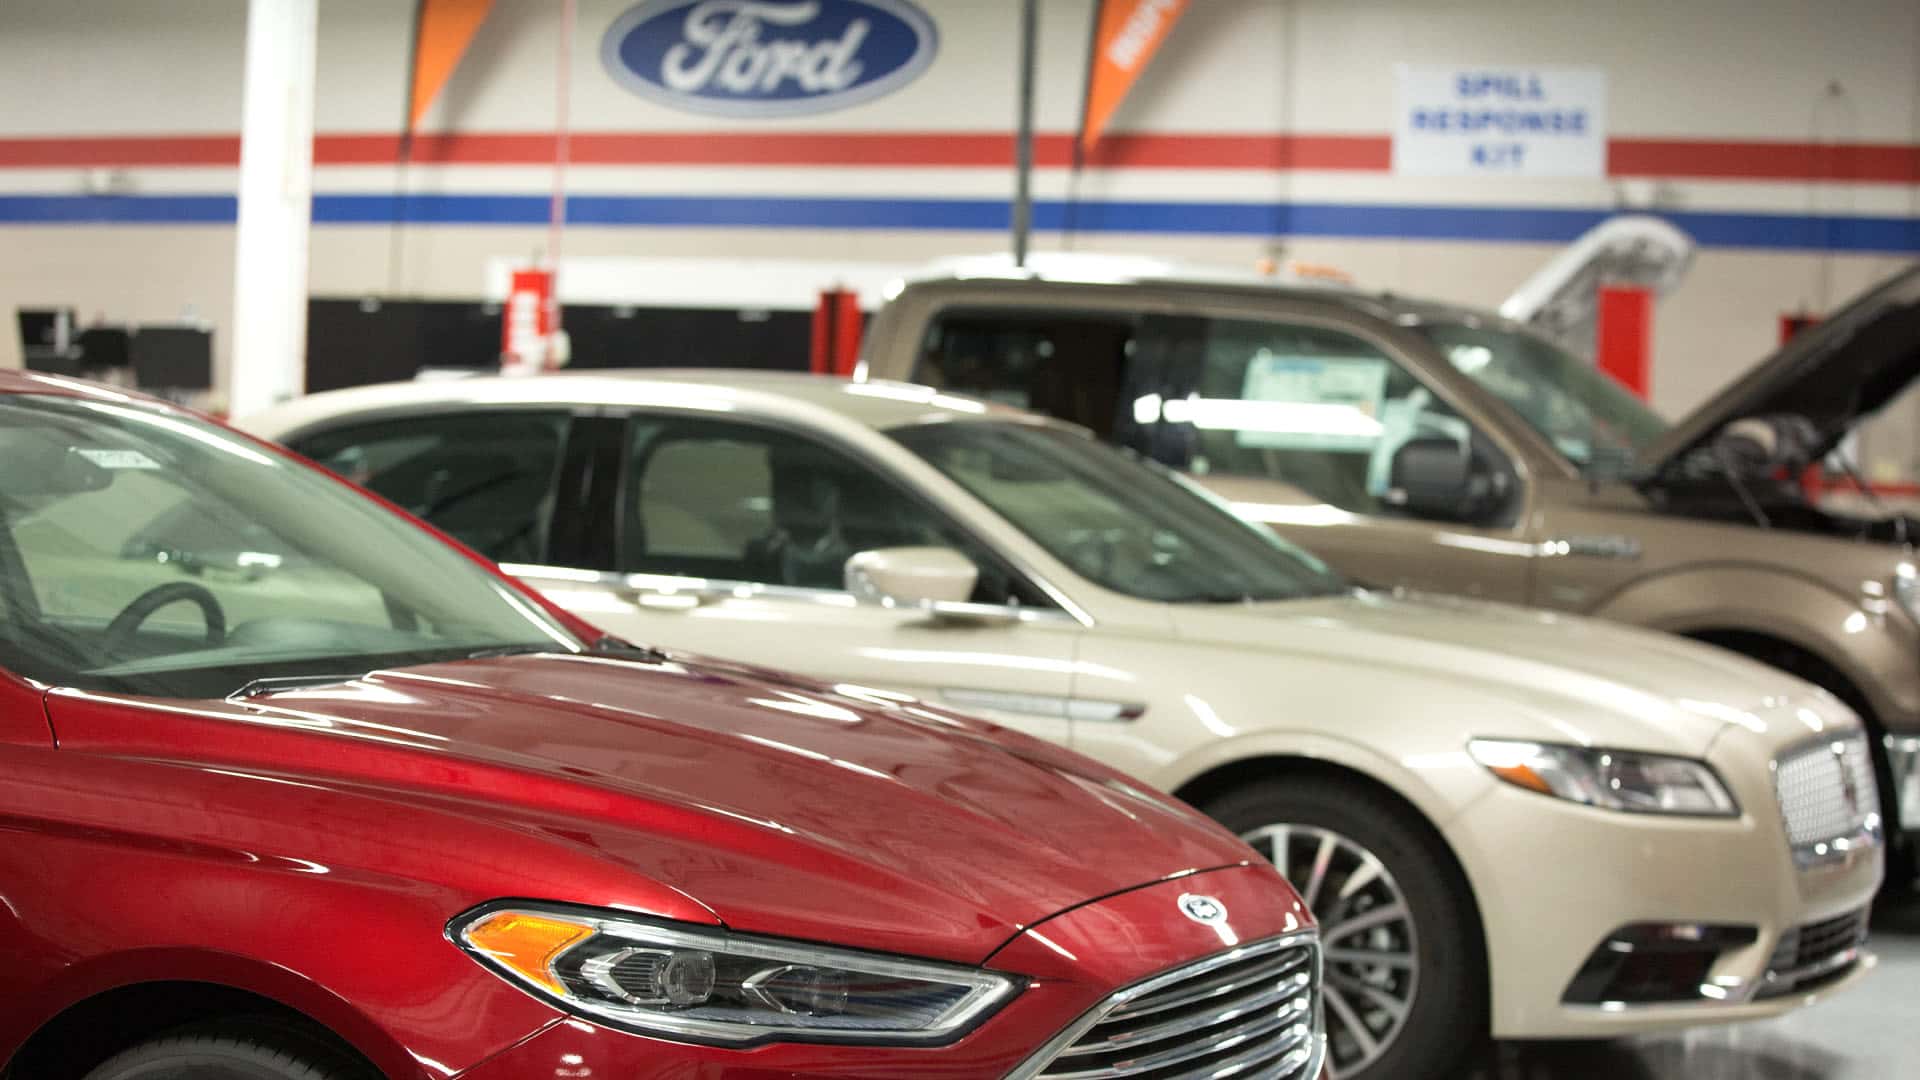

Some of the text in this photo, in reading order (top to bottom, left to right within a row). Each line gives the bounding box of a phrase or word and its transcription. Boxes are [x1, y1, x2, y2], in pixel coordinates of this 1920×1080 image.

[661, 0, 870, 92] Ford
[1456, 73, 1545, 98] SPILL
[1412, 108, 1589, 133] RESPONSE
[1470, 144, 1526, 169] KIT
